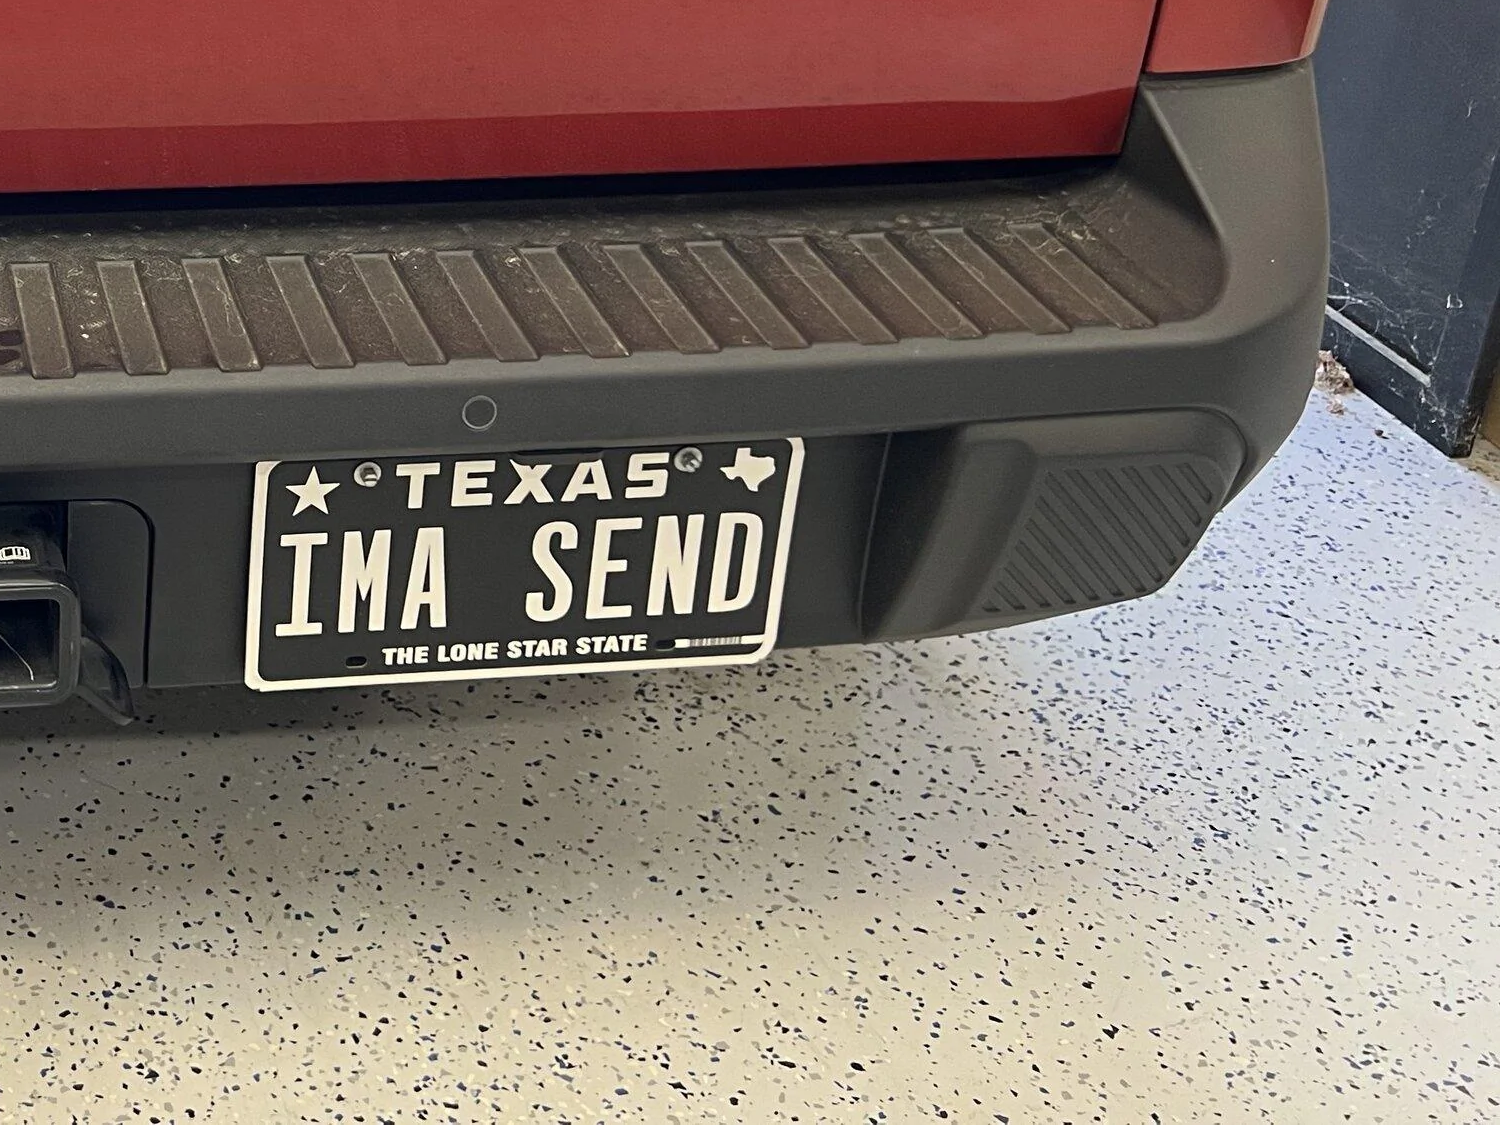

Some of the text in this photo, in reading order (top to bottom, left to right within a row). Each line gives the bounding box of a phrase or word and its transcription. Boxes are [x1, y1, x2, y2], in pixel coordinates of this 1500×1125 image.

[395, 452, 670, 509] TEXAS
[275, 511, 764, 637] IMA SEND
[382, 633, 648, 666] THE LONE STAR STATE
